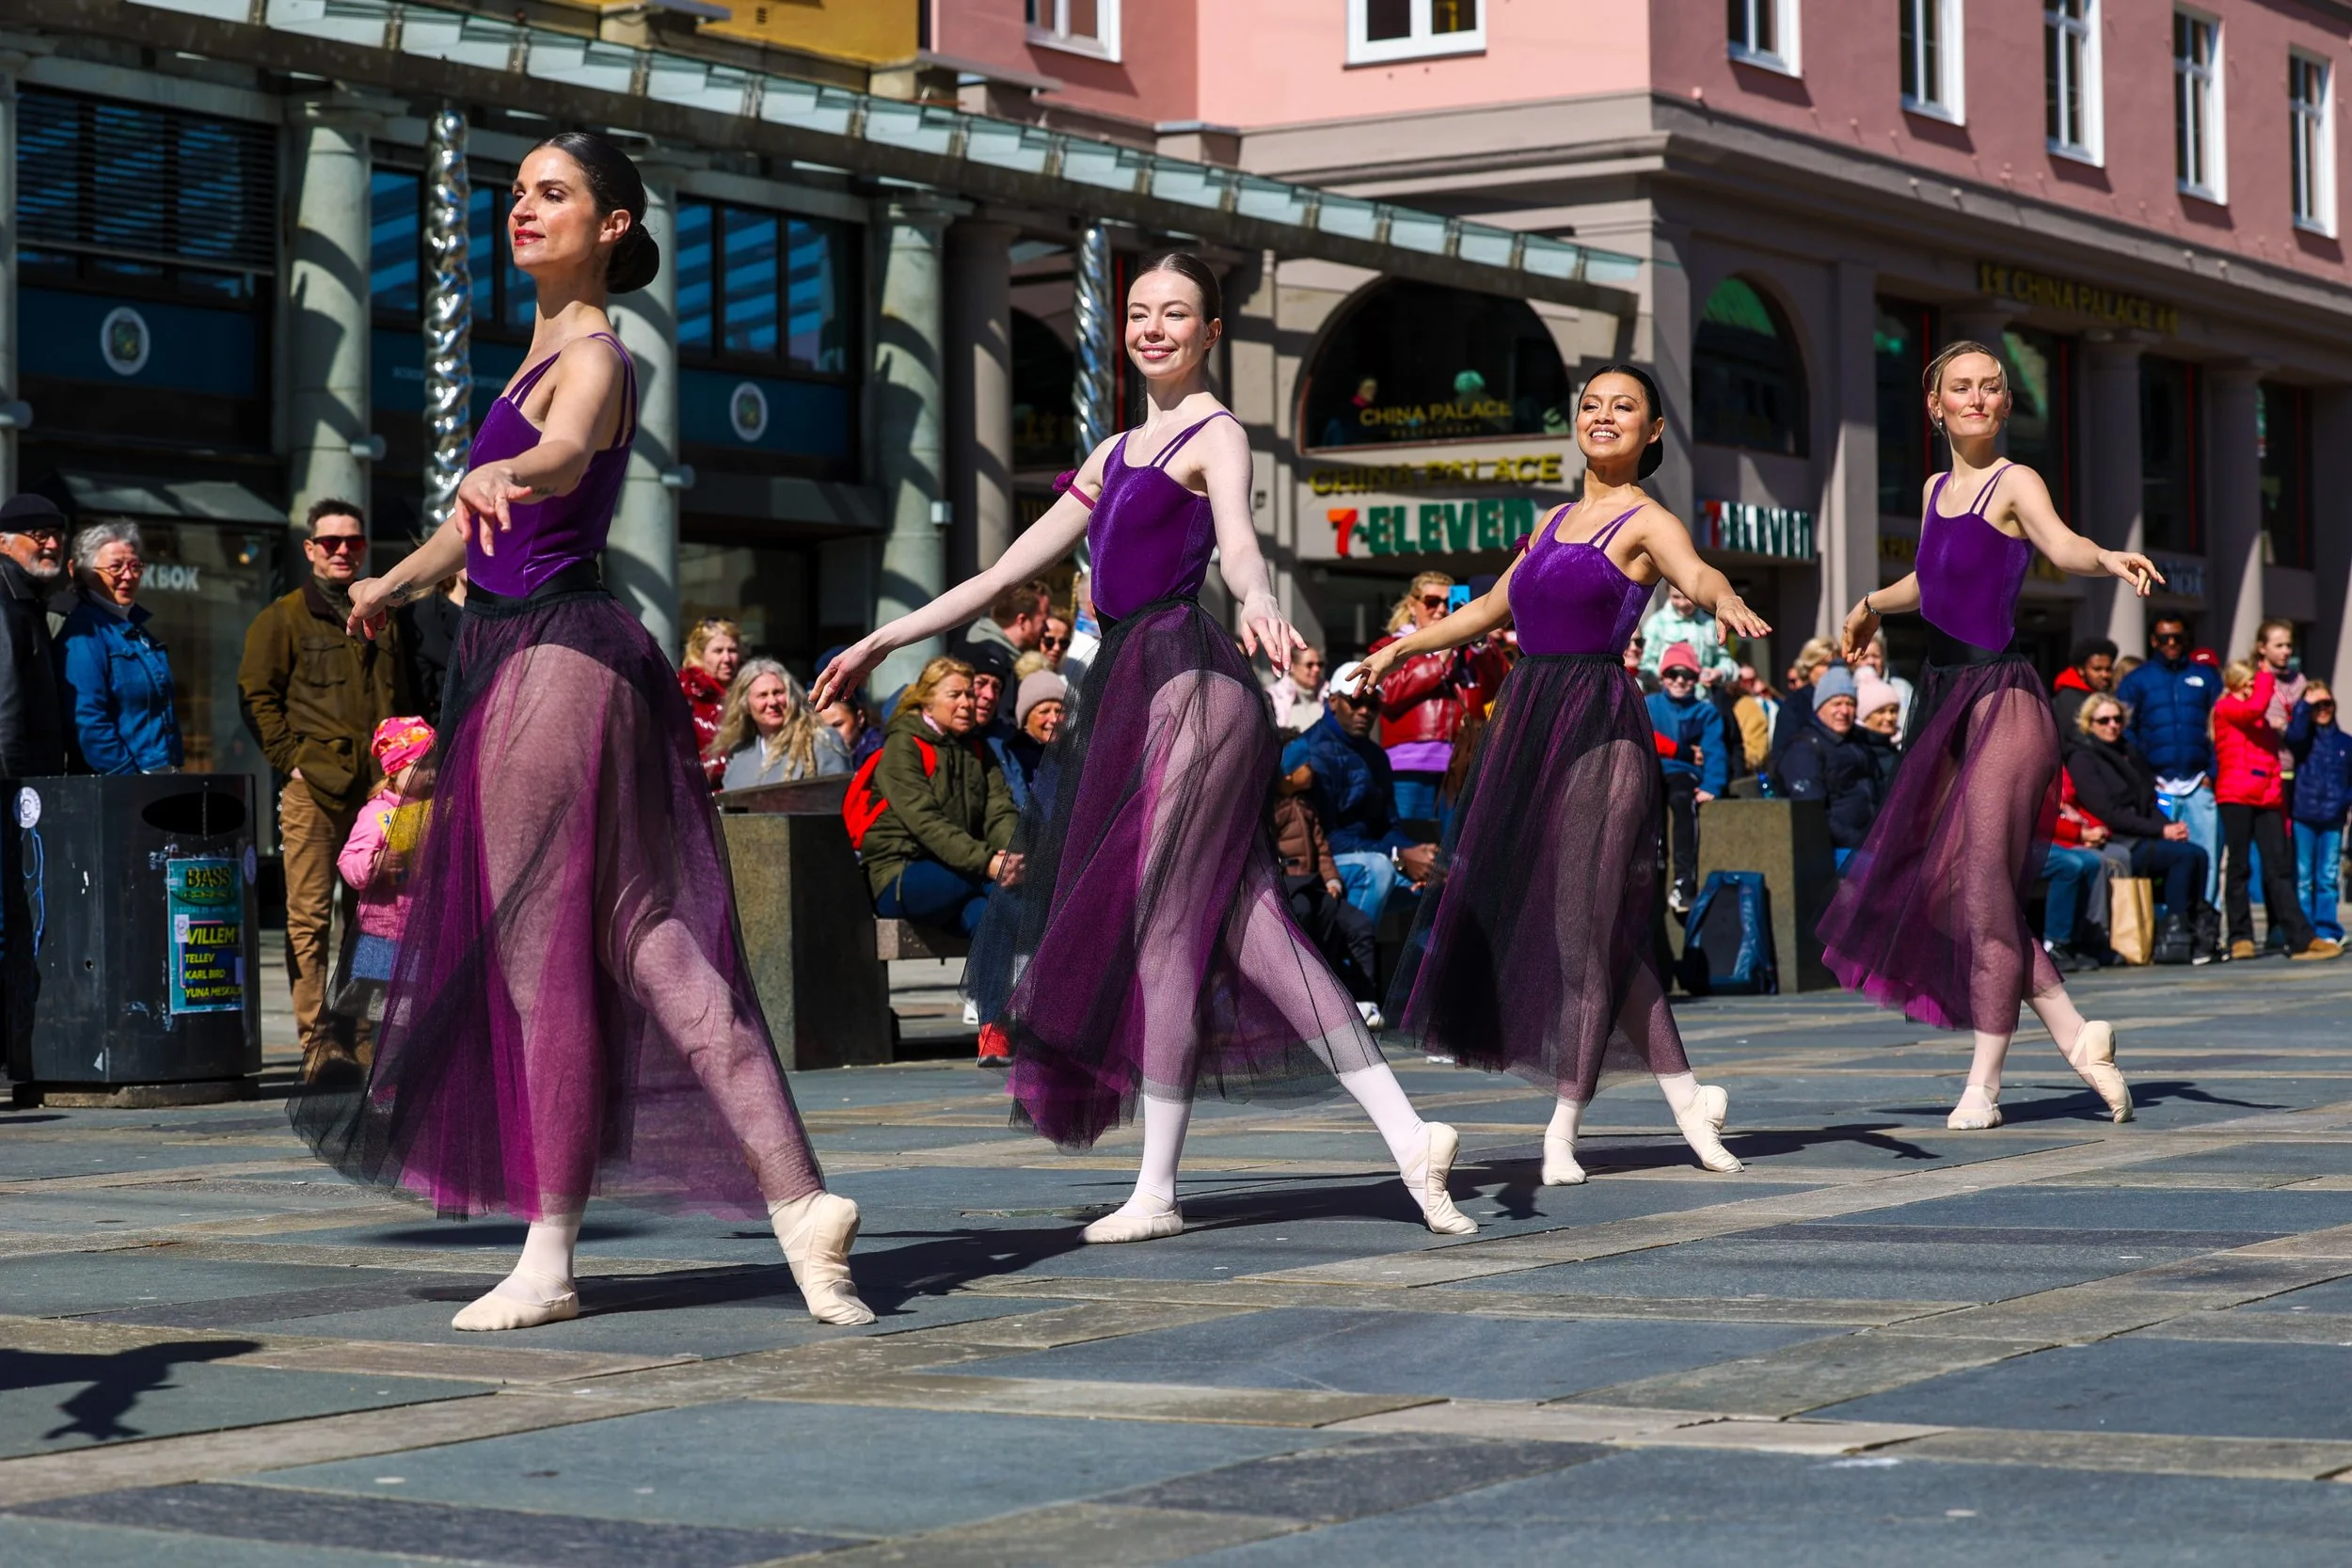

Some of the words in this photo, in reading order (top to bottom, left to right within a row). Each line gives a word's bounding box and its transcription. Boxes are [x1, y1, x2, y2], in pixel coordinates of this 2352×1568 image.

[2078, 286, 2152, 330] PALACE
[1359, 405, 1425, 426] CHINA
[1430, 400, 1513, 420] PALACE
[1309, 464, 1415, 496] CHINA
[1424, 452, 1564, 484] PALACE
[187, 866, 232, 888] BASS
[184, 953, 215, 964] TELLEV
[185, 969, 207, 980] KARL
[185, 987, 209, 998] YUNA
